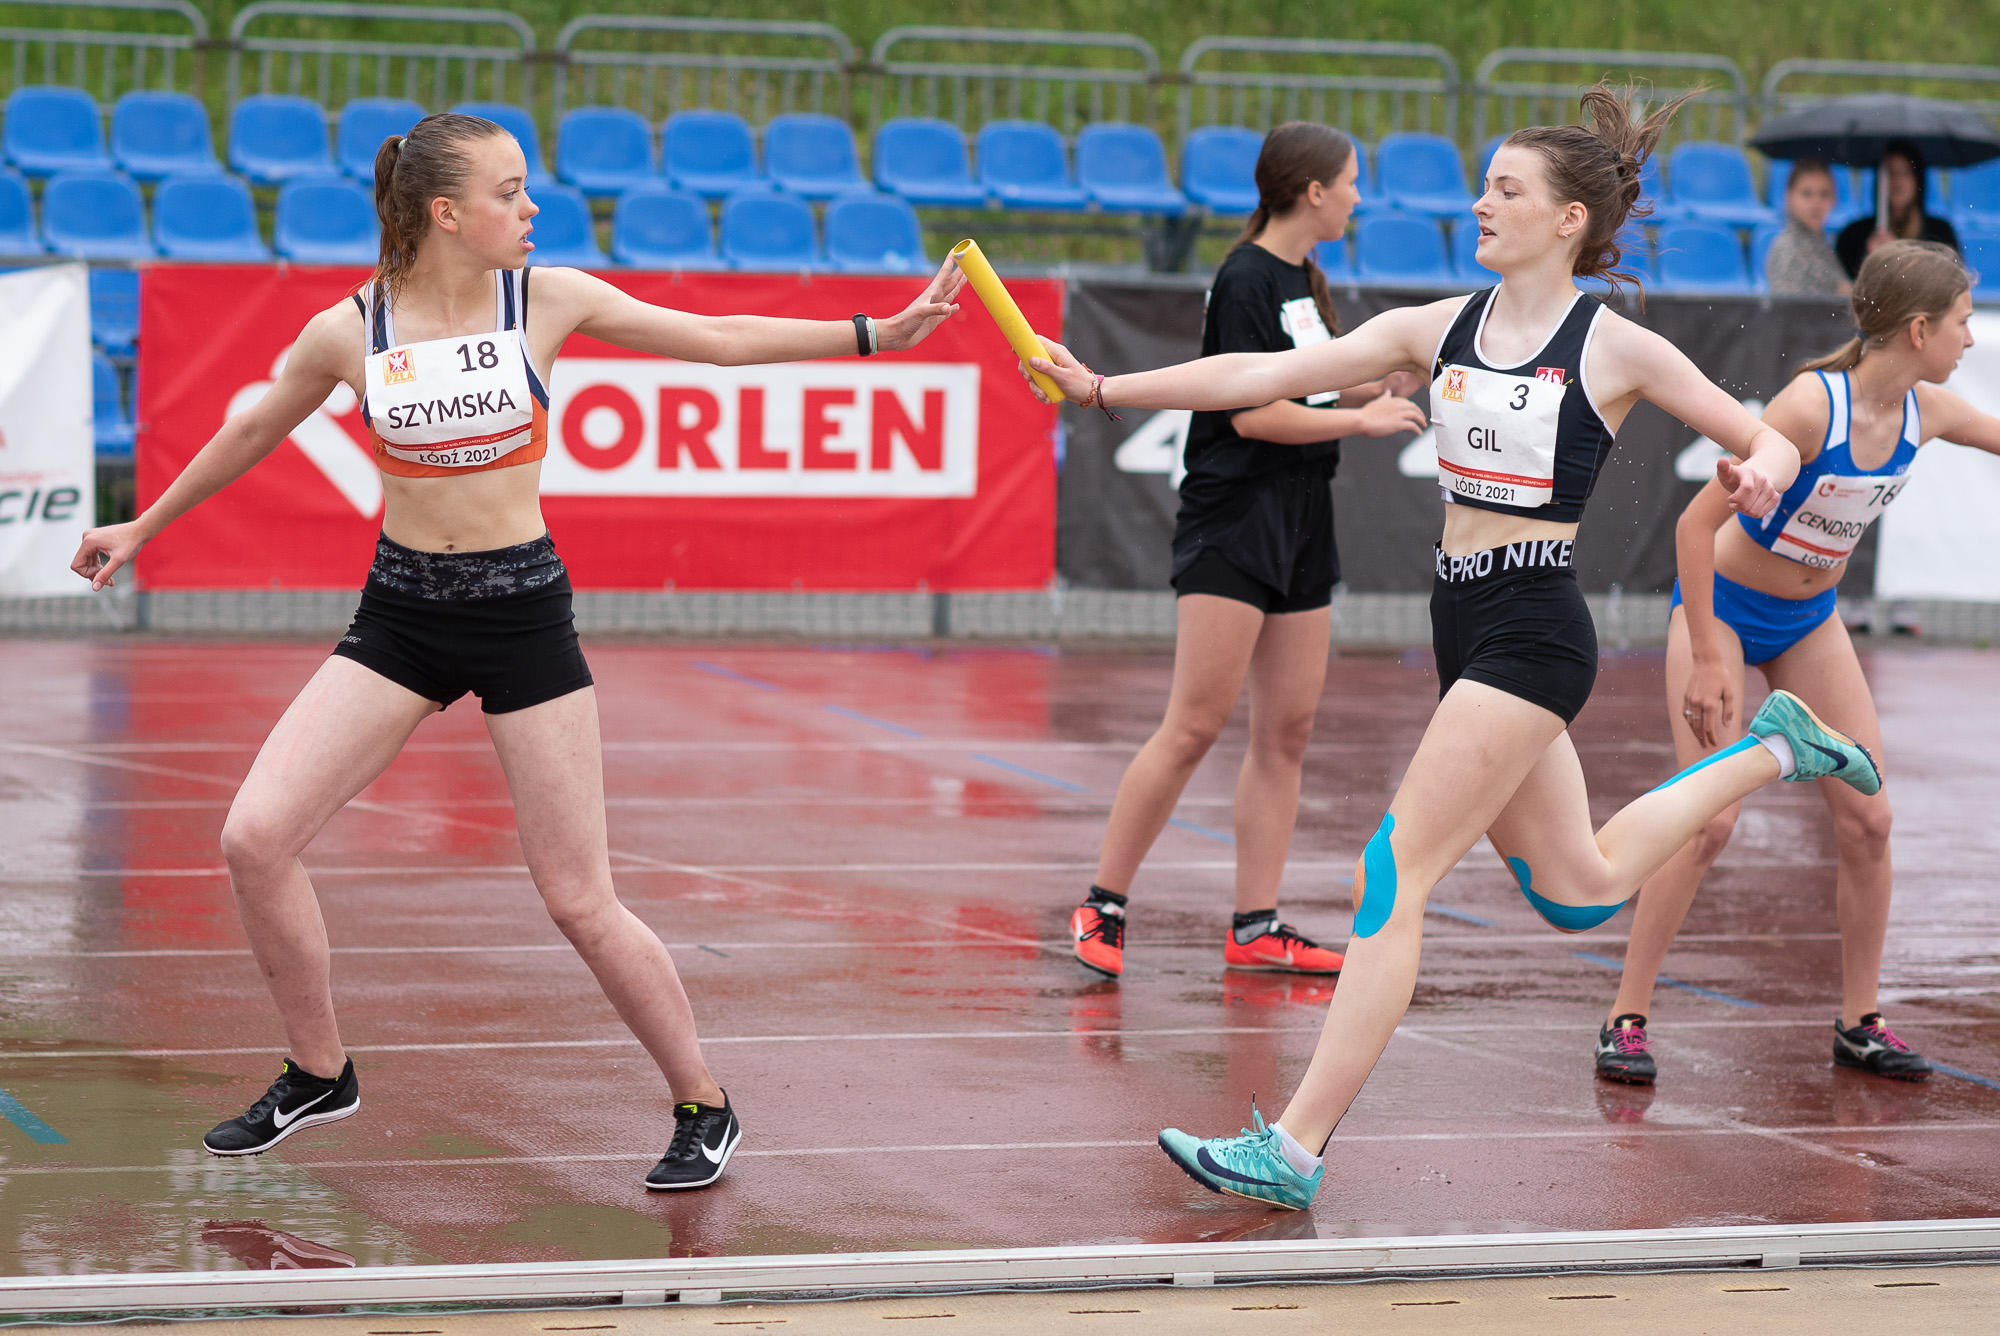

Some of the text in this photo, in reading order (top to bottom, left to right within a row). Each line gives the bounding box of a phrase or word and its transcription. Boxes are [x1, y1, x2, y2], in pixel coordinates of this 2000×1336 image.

[456, 341, 499, 373] 18
[386, 371, 414, 384] PZLA
[1443, 388, 1463, 401] PZLA
[1509, 384, 1530, 411] 3
[387, 388, 517, 430] SZYMSKA
[560, 382, 948, 473] ORLEN
[1467, 426, 1502, 453] GIL
[419, 446, 497, 465] ŁÓDŹ 2021
[1455, 477, 1482, 497] ŁÓDŹ
[1485, 485, 1515, 501] 2021
[1868, 481, 1906, 507] 76
[1798, 511, 1867, 538] CENDRO
[1450, 549, 1494, 583] PRO
[1503, 539, 1573, 571] NIKE
